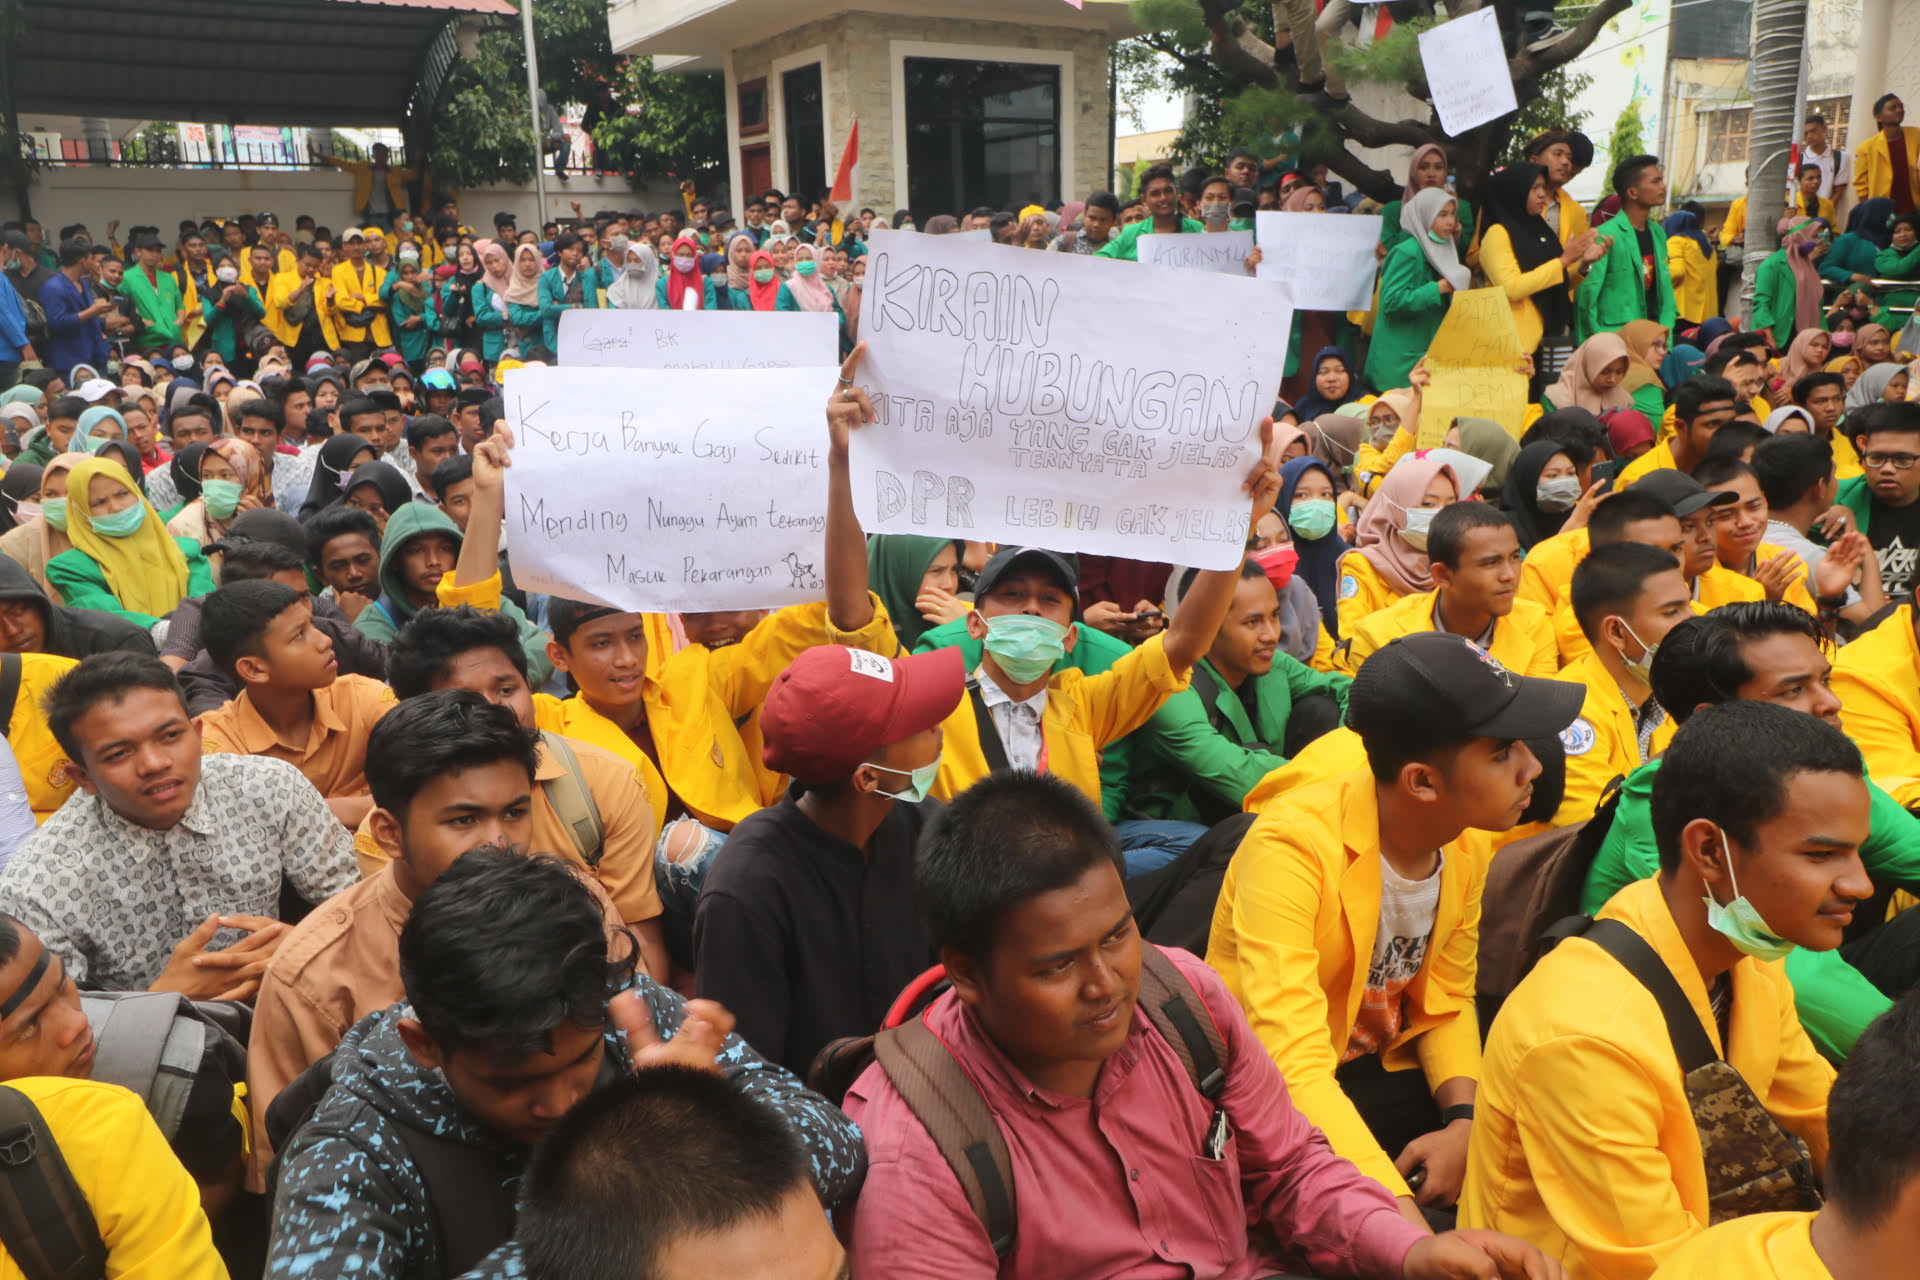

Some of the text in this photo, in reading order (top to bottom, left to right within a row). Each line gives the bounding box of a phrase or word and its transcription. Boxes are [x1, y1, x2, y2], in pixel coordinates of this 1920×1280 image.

[871, 253, 1059, 348] KIRAIN
[863, 385, 1245, 470] KITA AJA YANG GAK JELAS
[959, 342, 1259, 444] HUBUNGAN
[518, 395, 820, 469] Kerja Banyak Gaji Sedikit
[1009, 447, 1148, 479] TERNYATA
[520, 492, 826, 539] Mending Nunggu Ayam tetangg
[876, 470, 1251, 546] DPR LEBIH GAK JELAS
[607, 553, 772, 585] Masuk Pekarangan
